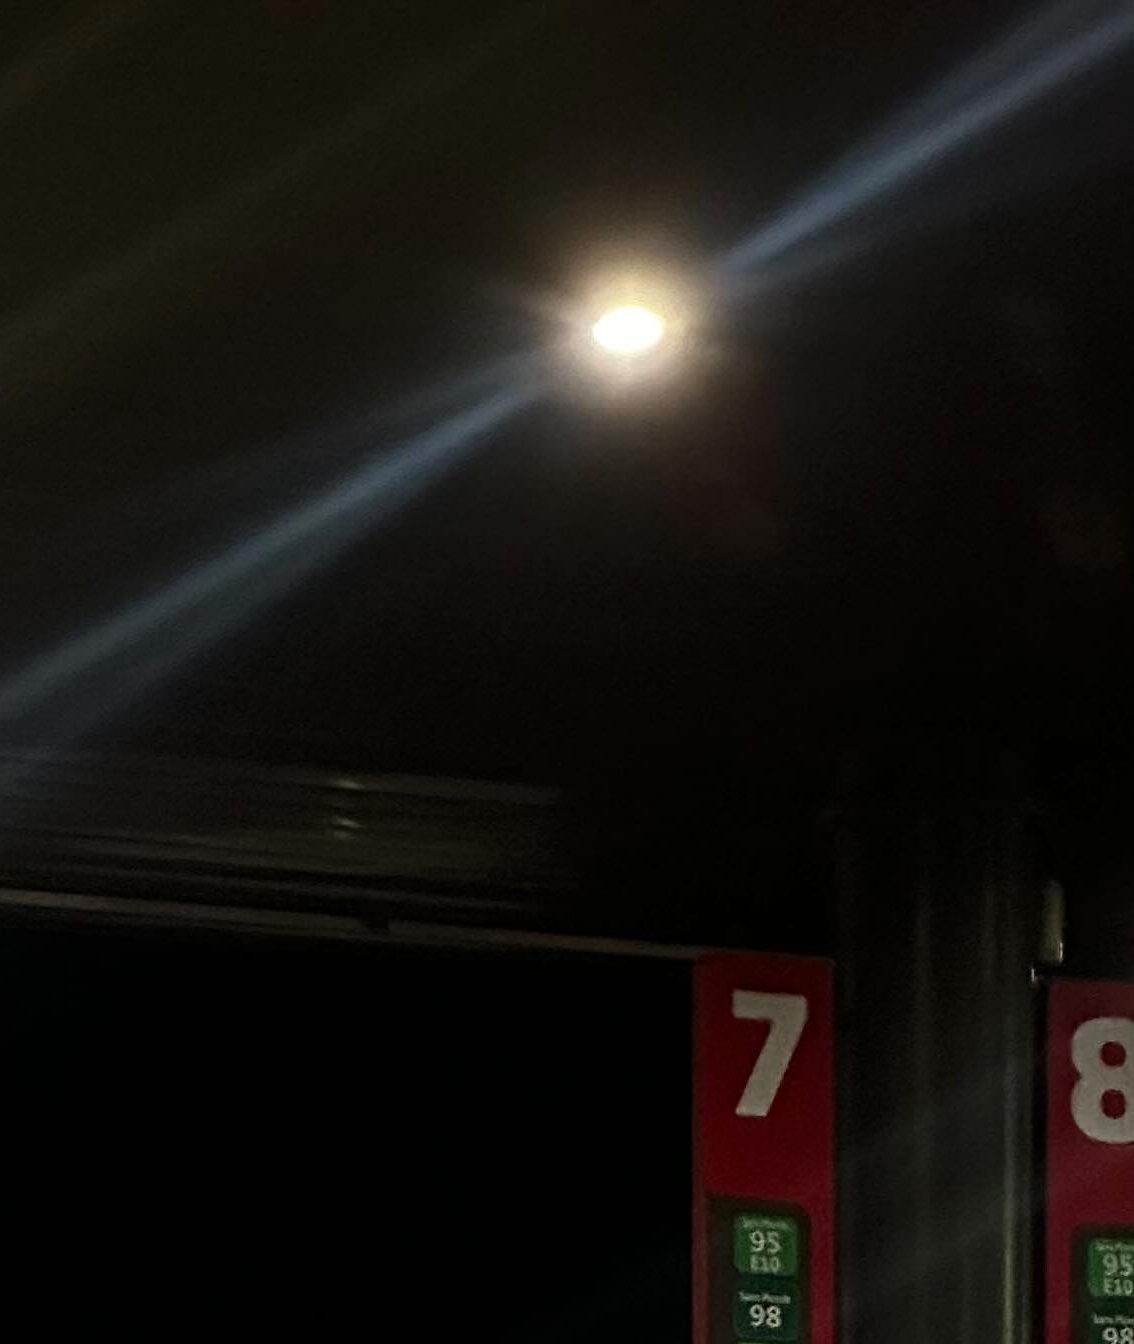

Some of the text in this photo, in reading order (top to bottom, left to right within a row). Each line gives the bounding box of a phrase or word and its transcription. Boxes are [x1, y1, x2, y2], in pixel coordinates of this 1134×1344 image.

[732, 989, 808, 1117] 7
[1070, 1016, 1134, 1144] 8
[749, 1230, 782, 1254] 95
[1103, 1253, 1134, 1276] 95
[1104, 1277, 1134, 1296] E10
[749, 1304, 782, 1328] 98
